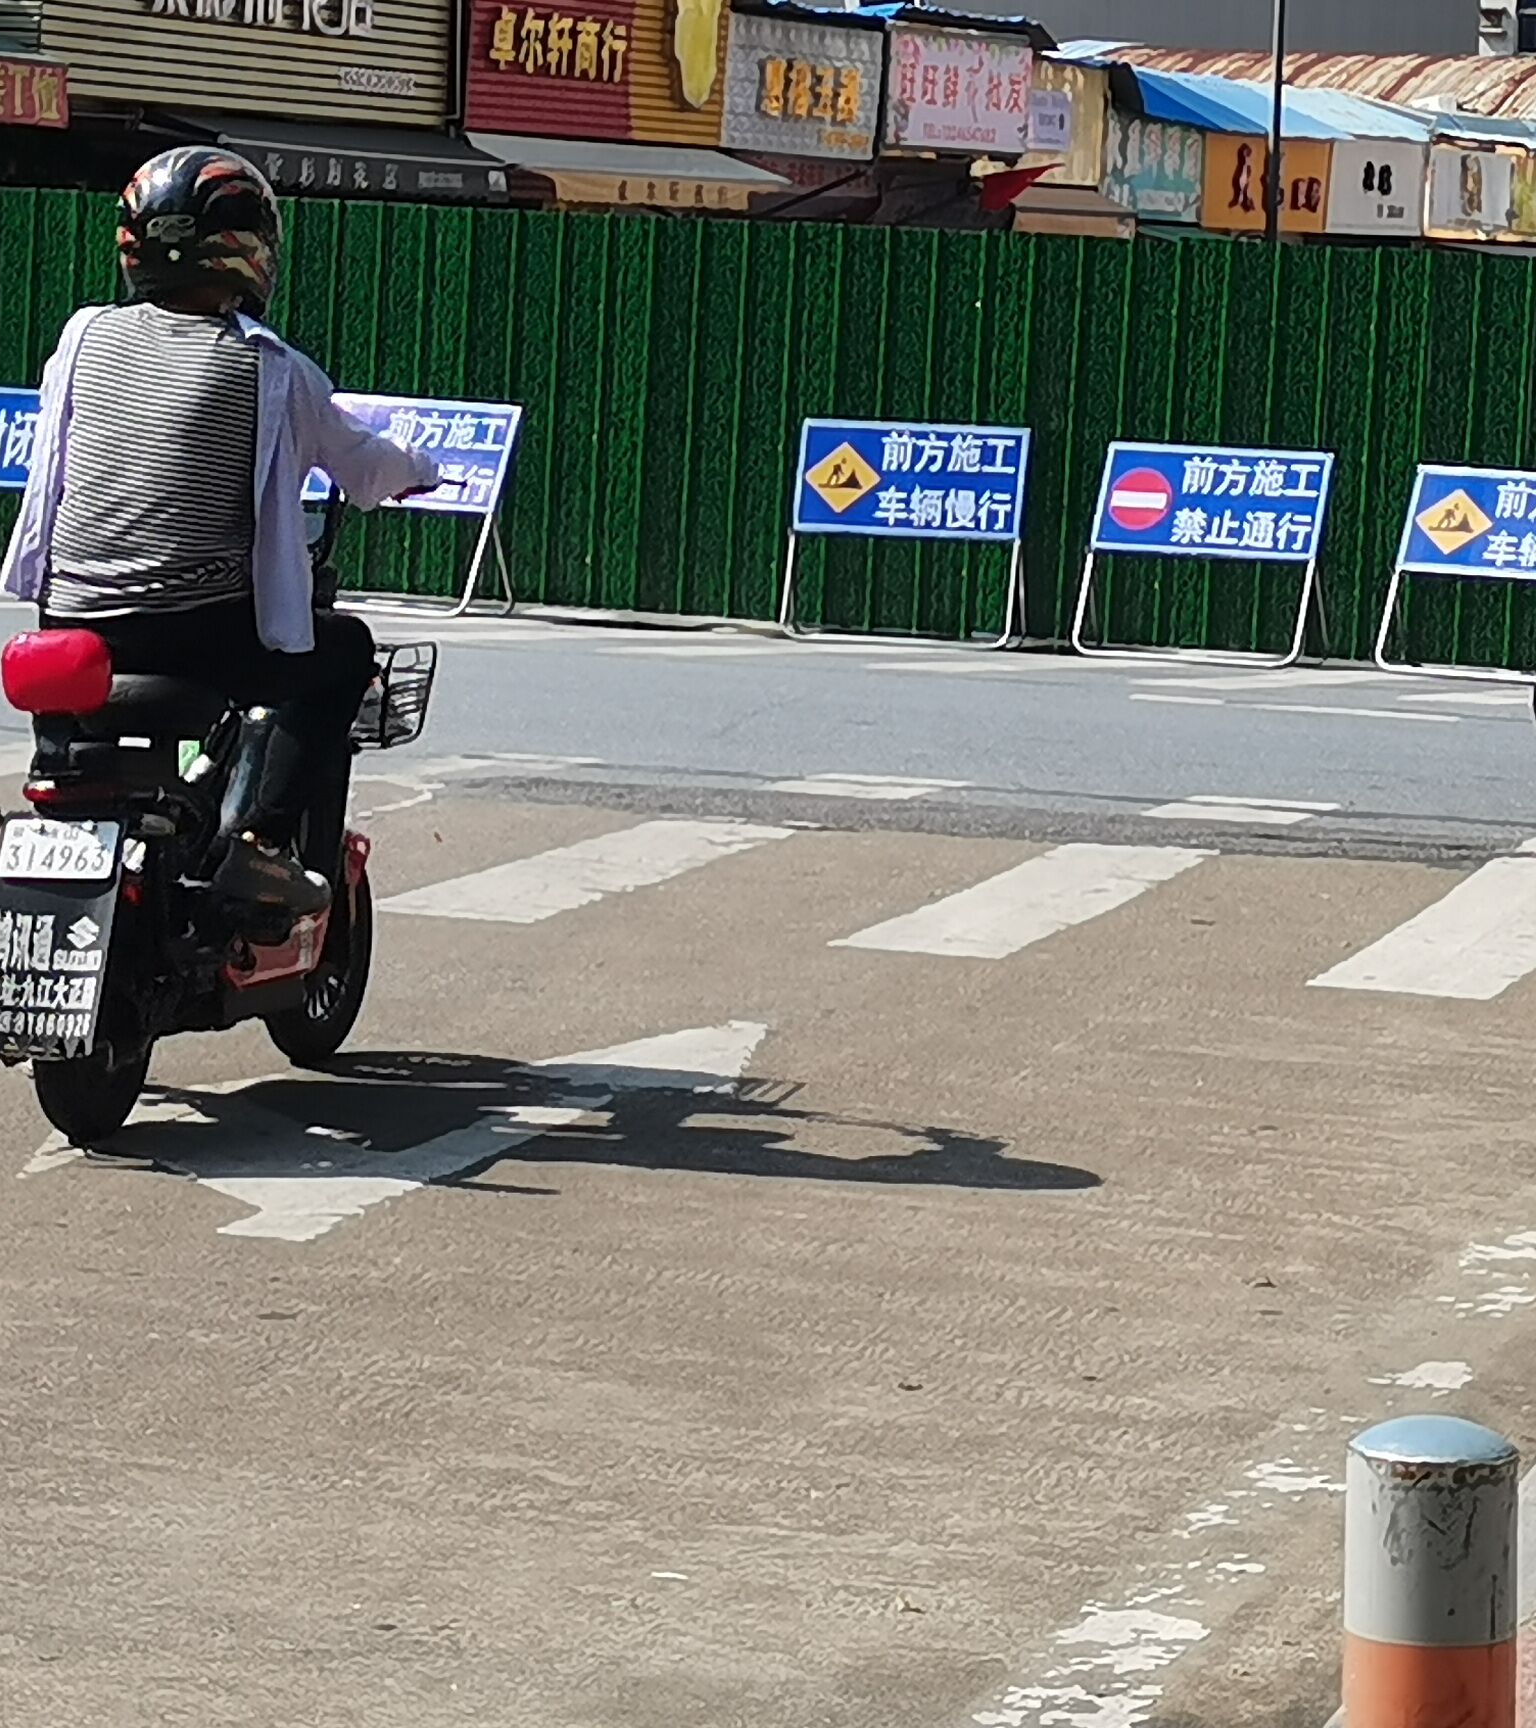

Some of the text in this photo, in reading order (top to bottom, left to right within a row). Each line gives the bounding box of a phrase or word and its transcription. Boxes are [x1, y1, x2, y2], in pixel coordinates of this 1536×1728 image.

[489, 5, 627, 83] 卓尔轩商行
[389, 408, 507, 451] 前方施工
[881, 430, 1017, 475] 前方施工
[1181, 454, 1320, 499] 前方施工
[873, 485, 1013, 532] 车辆慢行
[1170, 508, 1313, 552] 禁止通行
[6, 841, 105, 873] 314963
